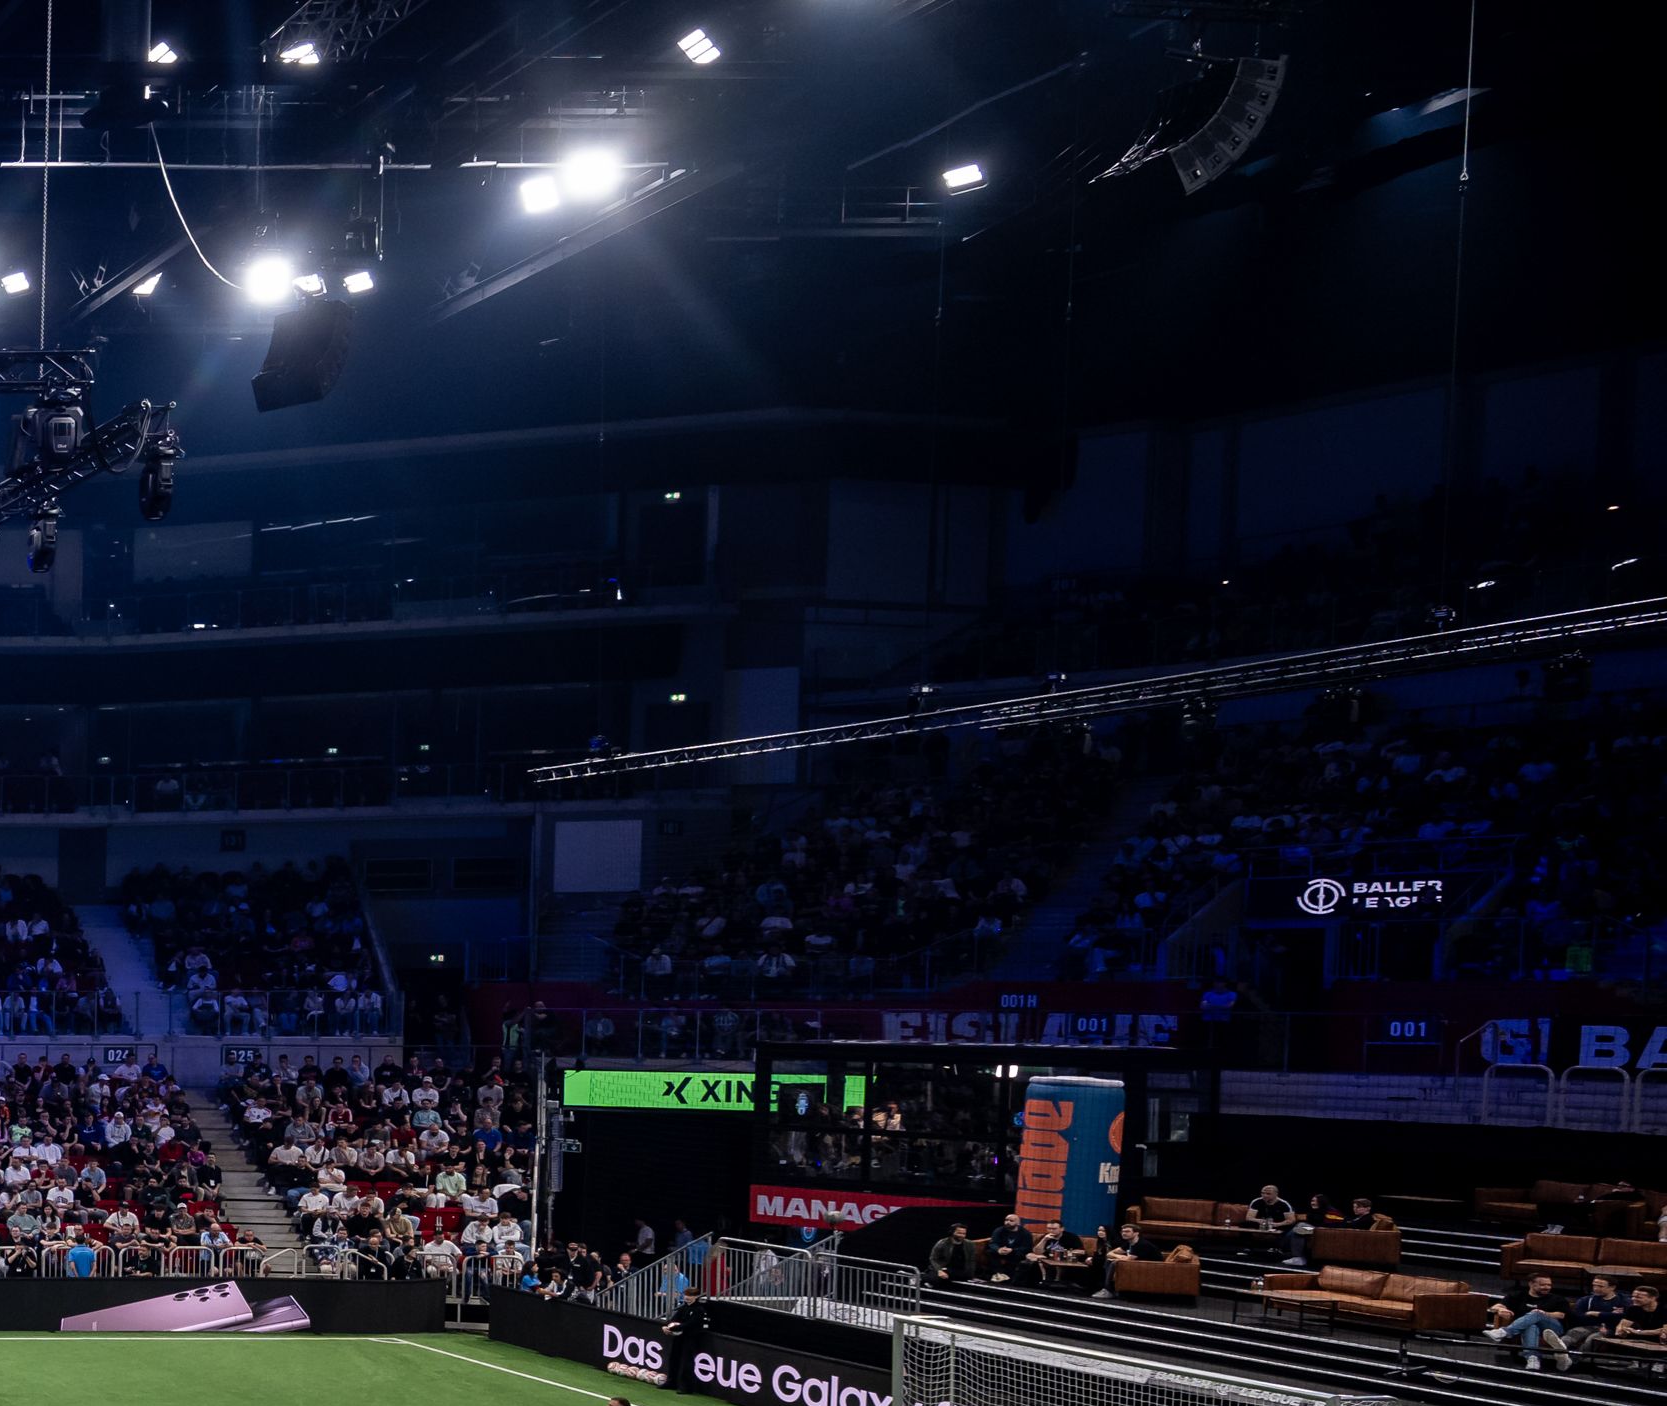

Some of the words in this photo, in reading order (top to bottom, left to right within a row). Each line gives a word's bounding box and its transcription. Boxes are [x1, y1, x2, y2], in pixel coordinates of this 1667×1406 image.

[1077, 1018, 1108, 1032] 001
[1389, 1020, 1427, 1039] 001
[756, 1194, 904, 1225] MANAG
[603, 1324, 663, 1368] Das
[694, 1352, 762, 1393] eue
